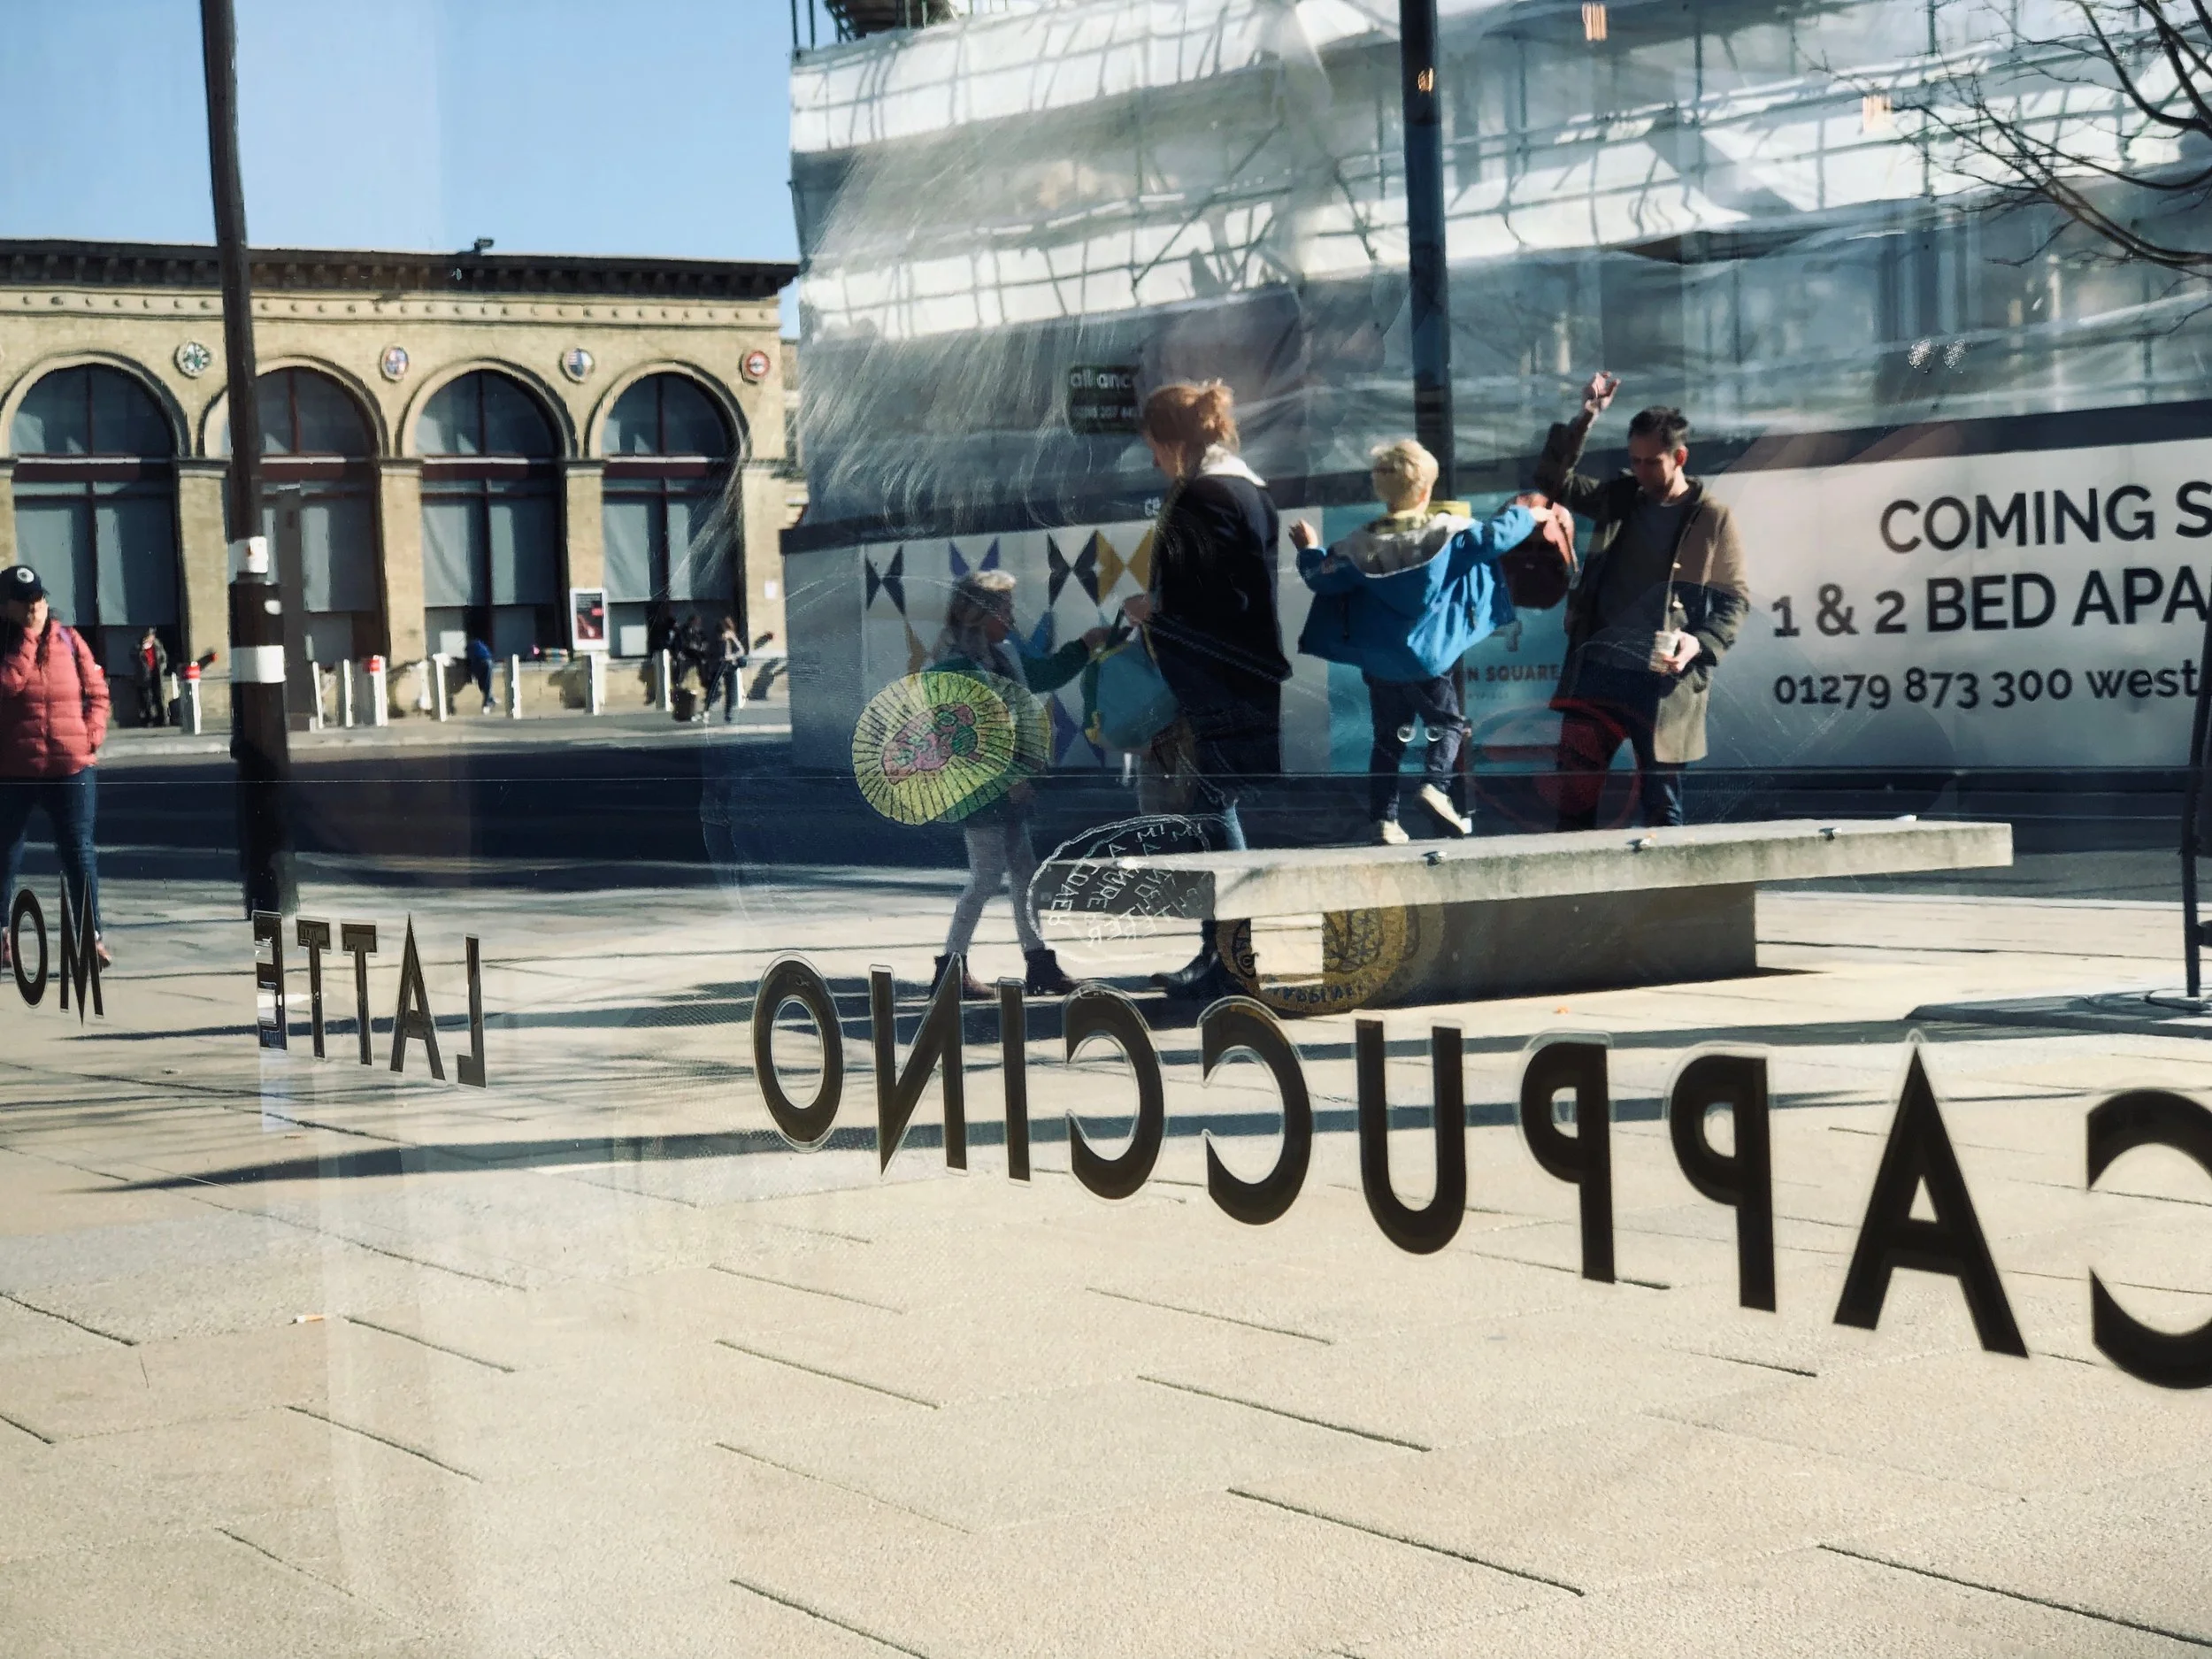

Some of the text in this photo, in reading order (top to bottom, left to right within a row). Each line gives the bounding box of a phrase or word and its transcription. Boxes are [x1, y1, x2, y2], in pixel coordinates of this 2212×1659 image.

[1880, 485, 2155, 554] COMING
[1772, 595, 1801, 637] 1
[1816, 583, 1860, 635] &
[1875, 590, 1907, 634] 2
[1927, 572, 2056, 633] BED
[1486, 664, 1560, 682] SQUARE
[1775, 673, 1890, 710] 01279
[1904, 666, 1980, 710] 873
[1992, 667, 2072, 709] 300
